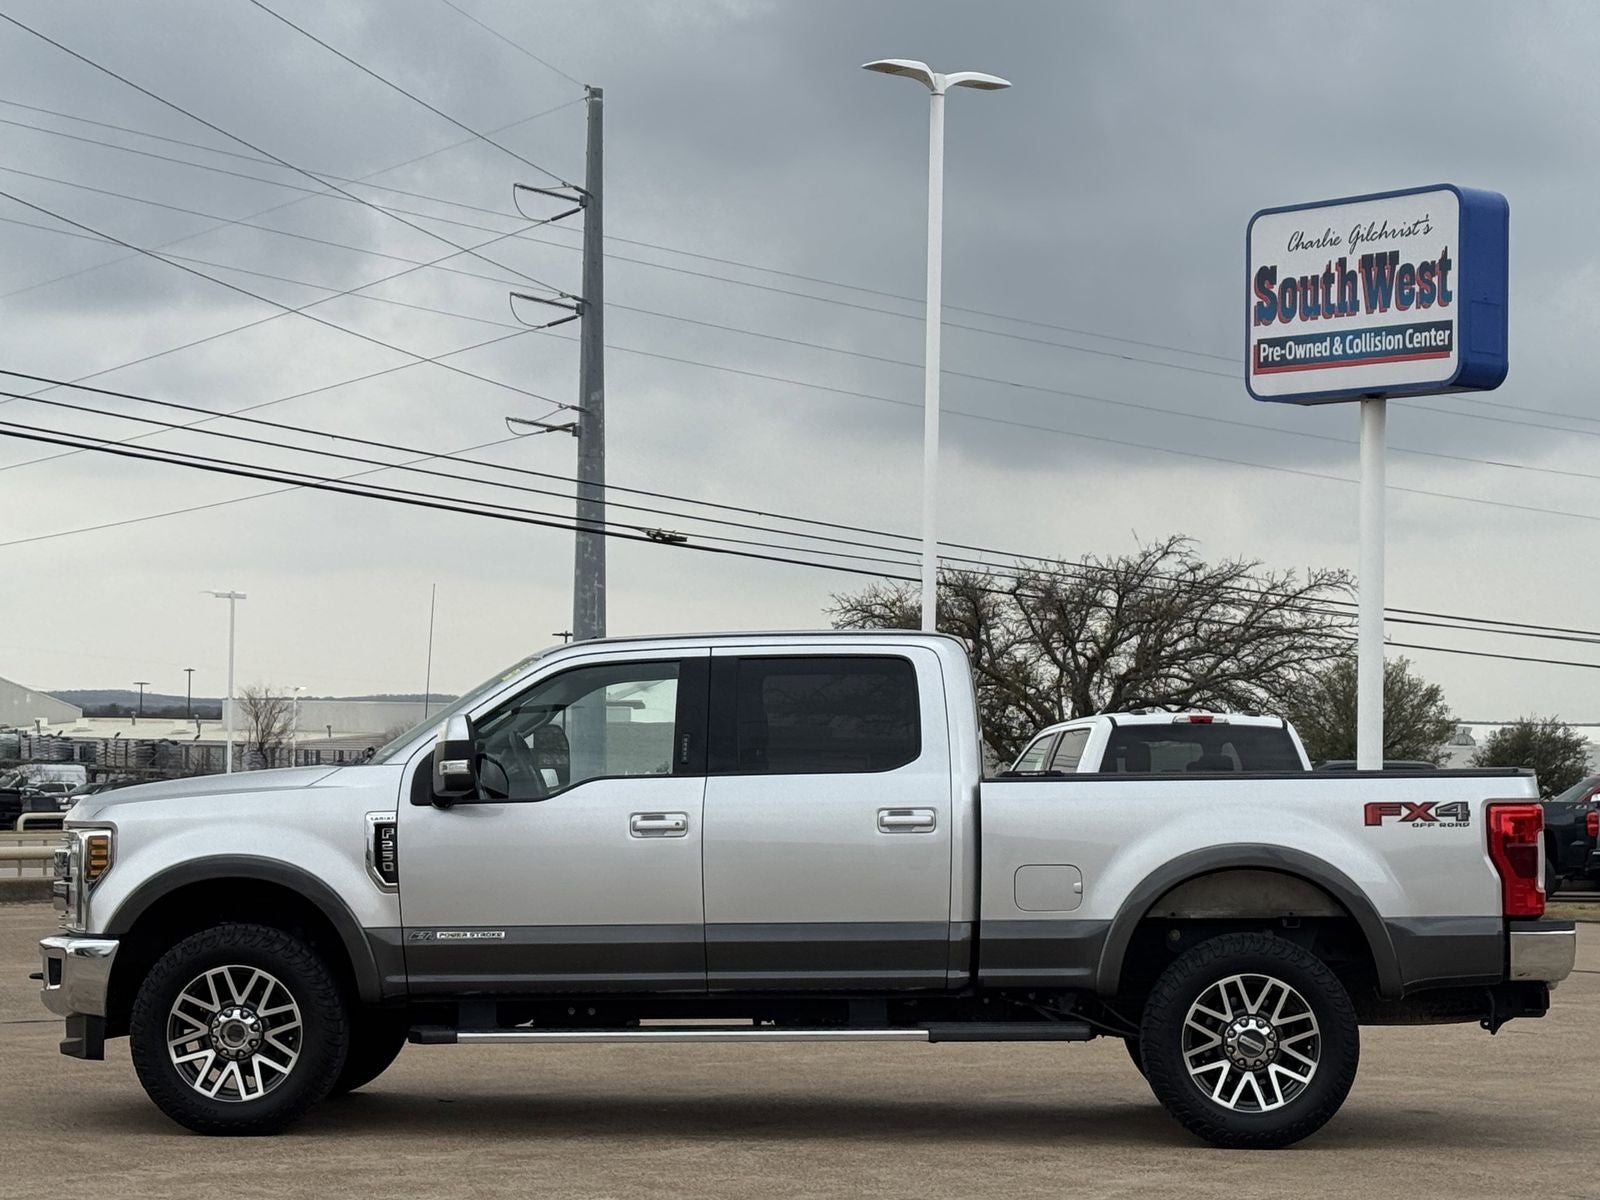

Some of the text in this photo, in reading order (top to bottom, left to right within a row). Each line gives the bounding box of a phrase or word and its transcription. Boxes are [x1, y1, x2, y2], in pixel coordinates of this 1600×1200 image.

[1287, 213, 1433, 255] Charlie Gilchrist's
[1254, 246, 1453, 327] SouthWest
[1260, 327, 1451, 363] Pre-Owned & Collision Center
[1364, 801, 1470, 826] FX4
